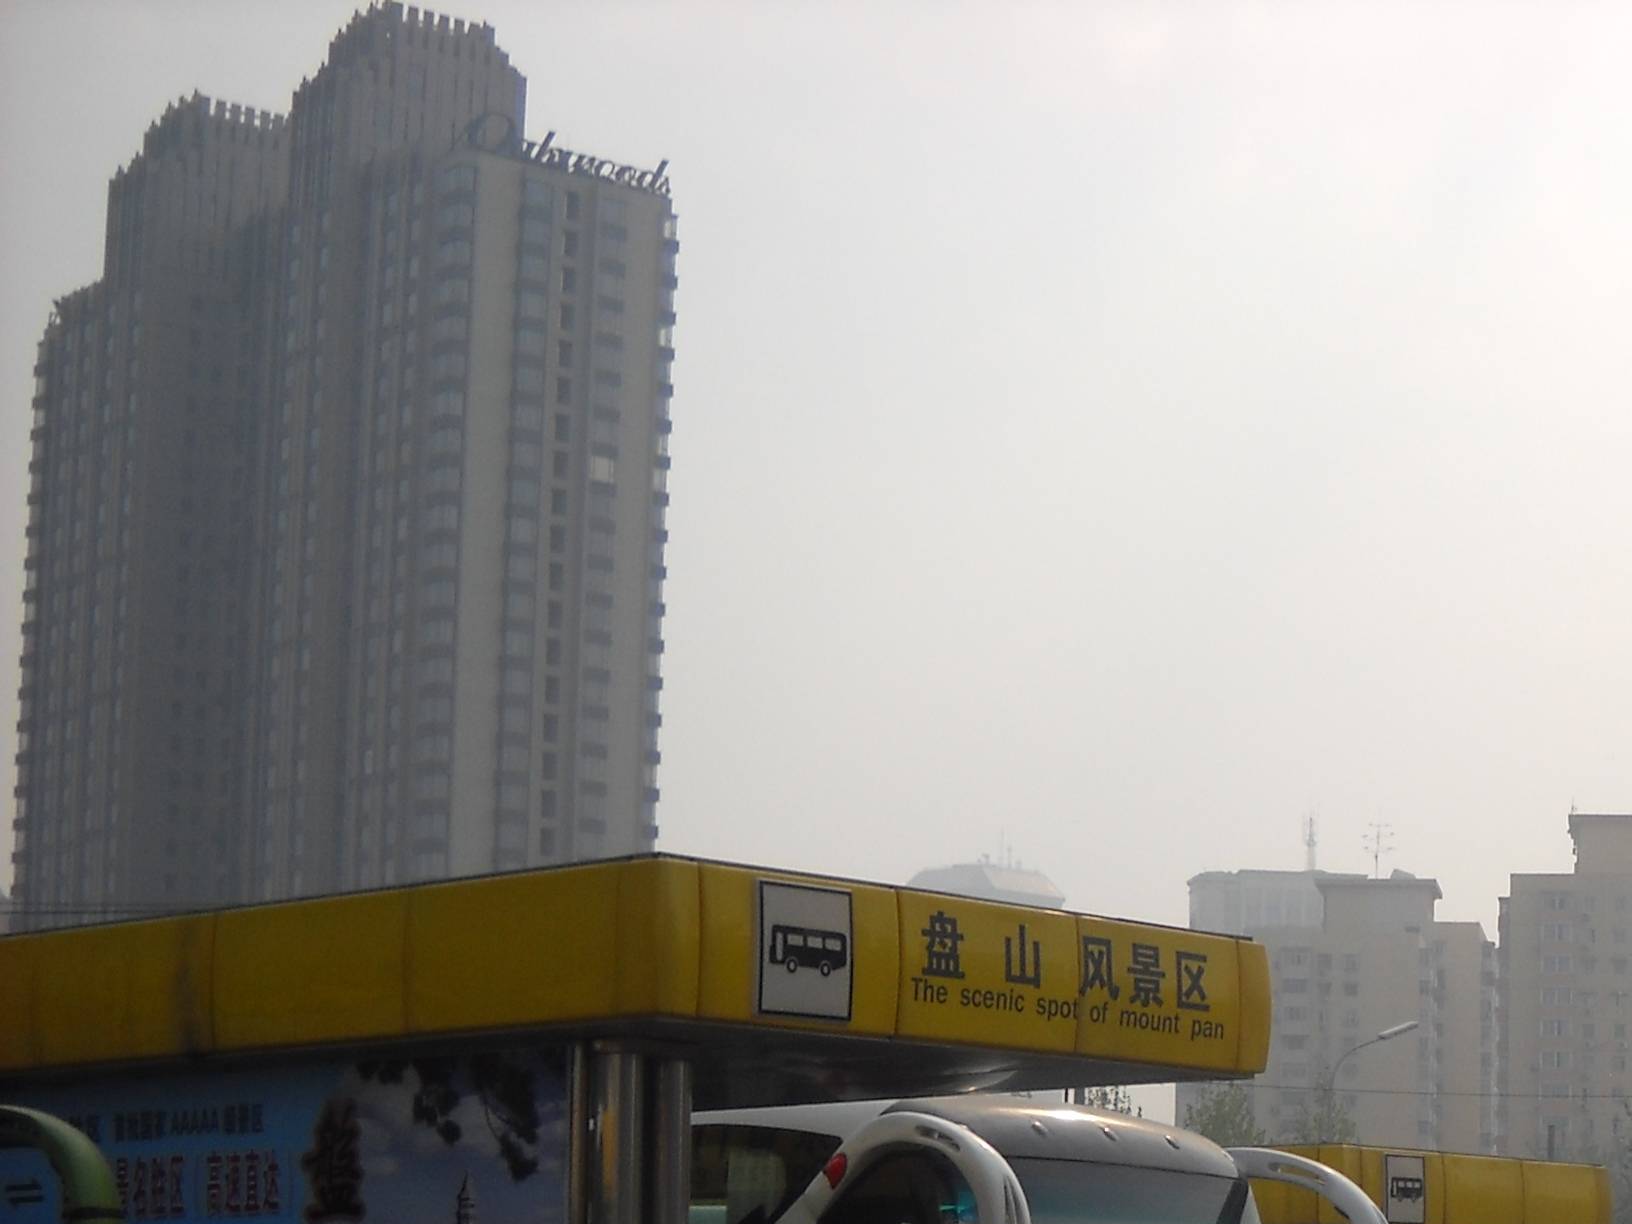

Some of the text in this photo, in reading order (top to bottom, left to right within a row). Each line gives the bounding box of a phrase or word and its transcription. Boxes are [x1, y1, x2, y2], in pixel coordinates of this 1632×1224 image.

[920, 909, 1211, 1012] 盘山风景区
[911, 977, 1225, 1042] The scenic spot of mount pan
